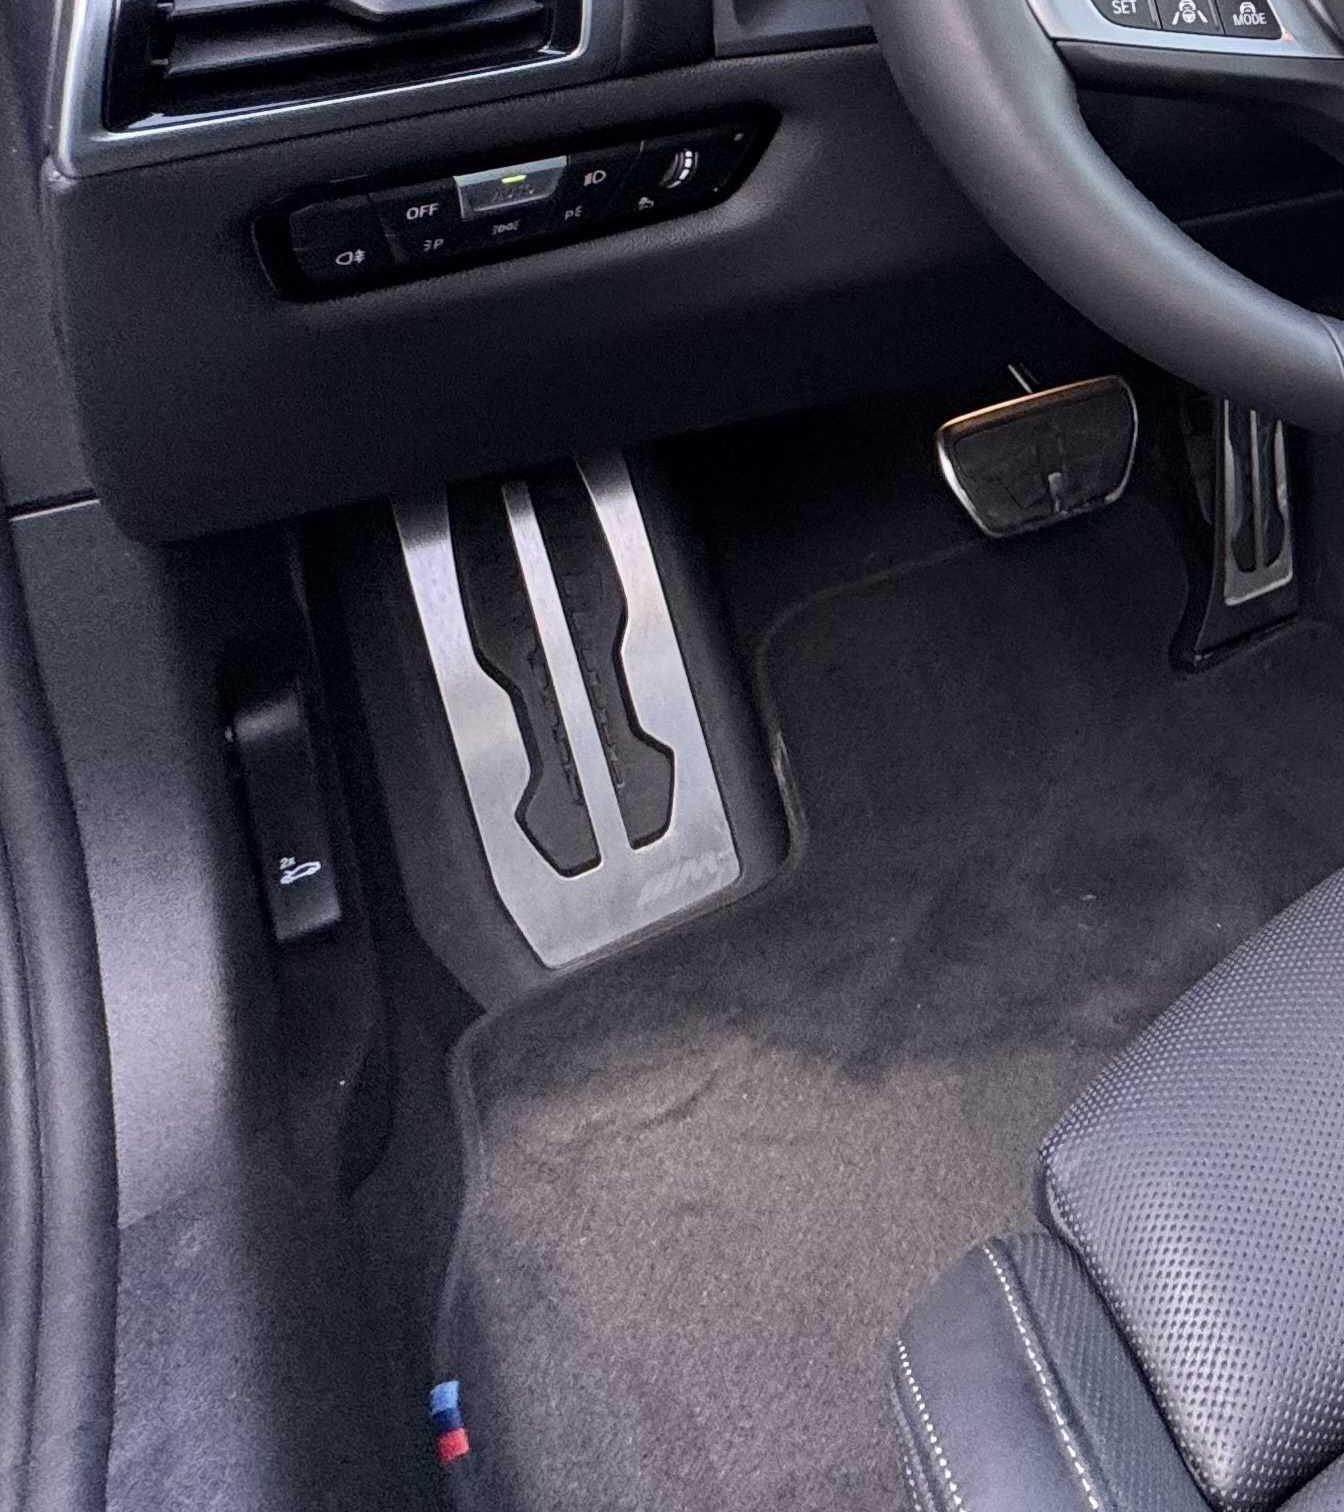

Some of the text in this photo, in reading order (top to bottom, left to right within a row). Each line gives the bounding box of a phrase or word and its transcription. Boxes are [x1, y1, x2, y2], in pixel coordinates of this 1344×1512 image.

[1111, 0, 1138, 15] SET
[1232, 12, 1267, 26] MODE
[406, 202, 440, 220] OFF
